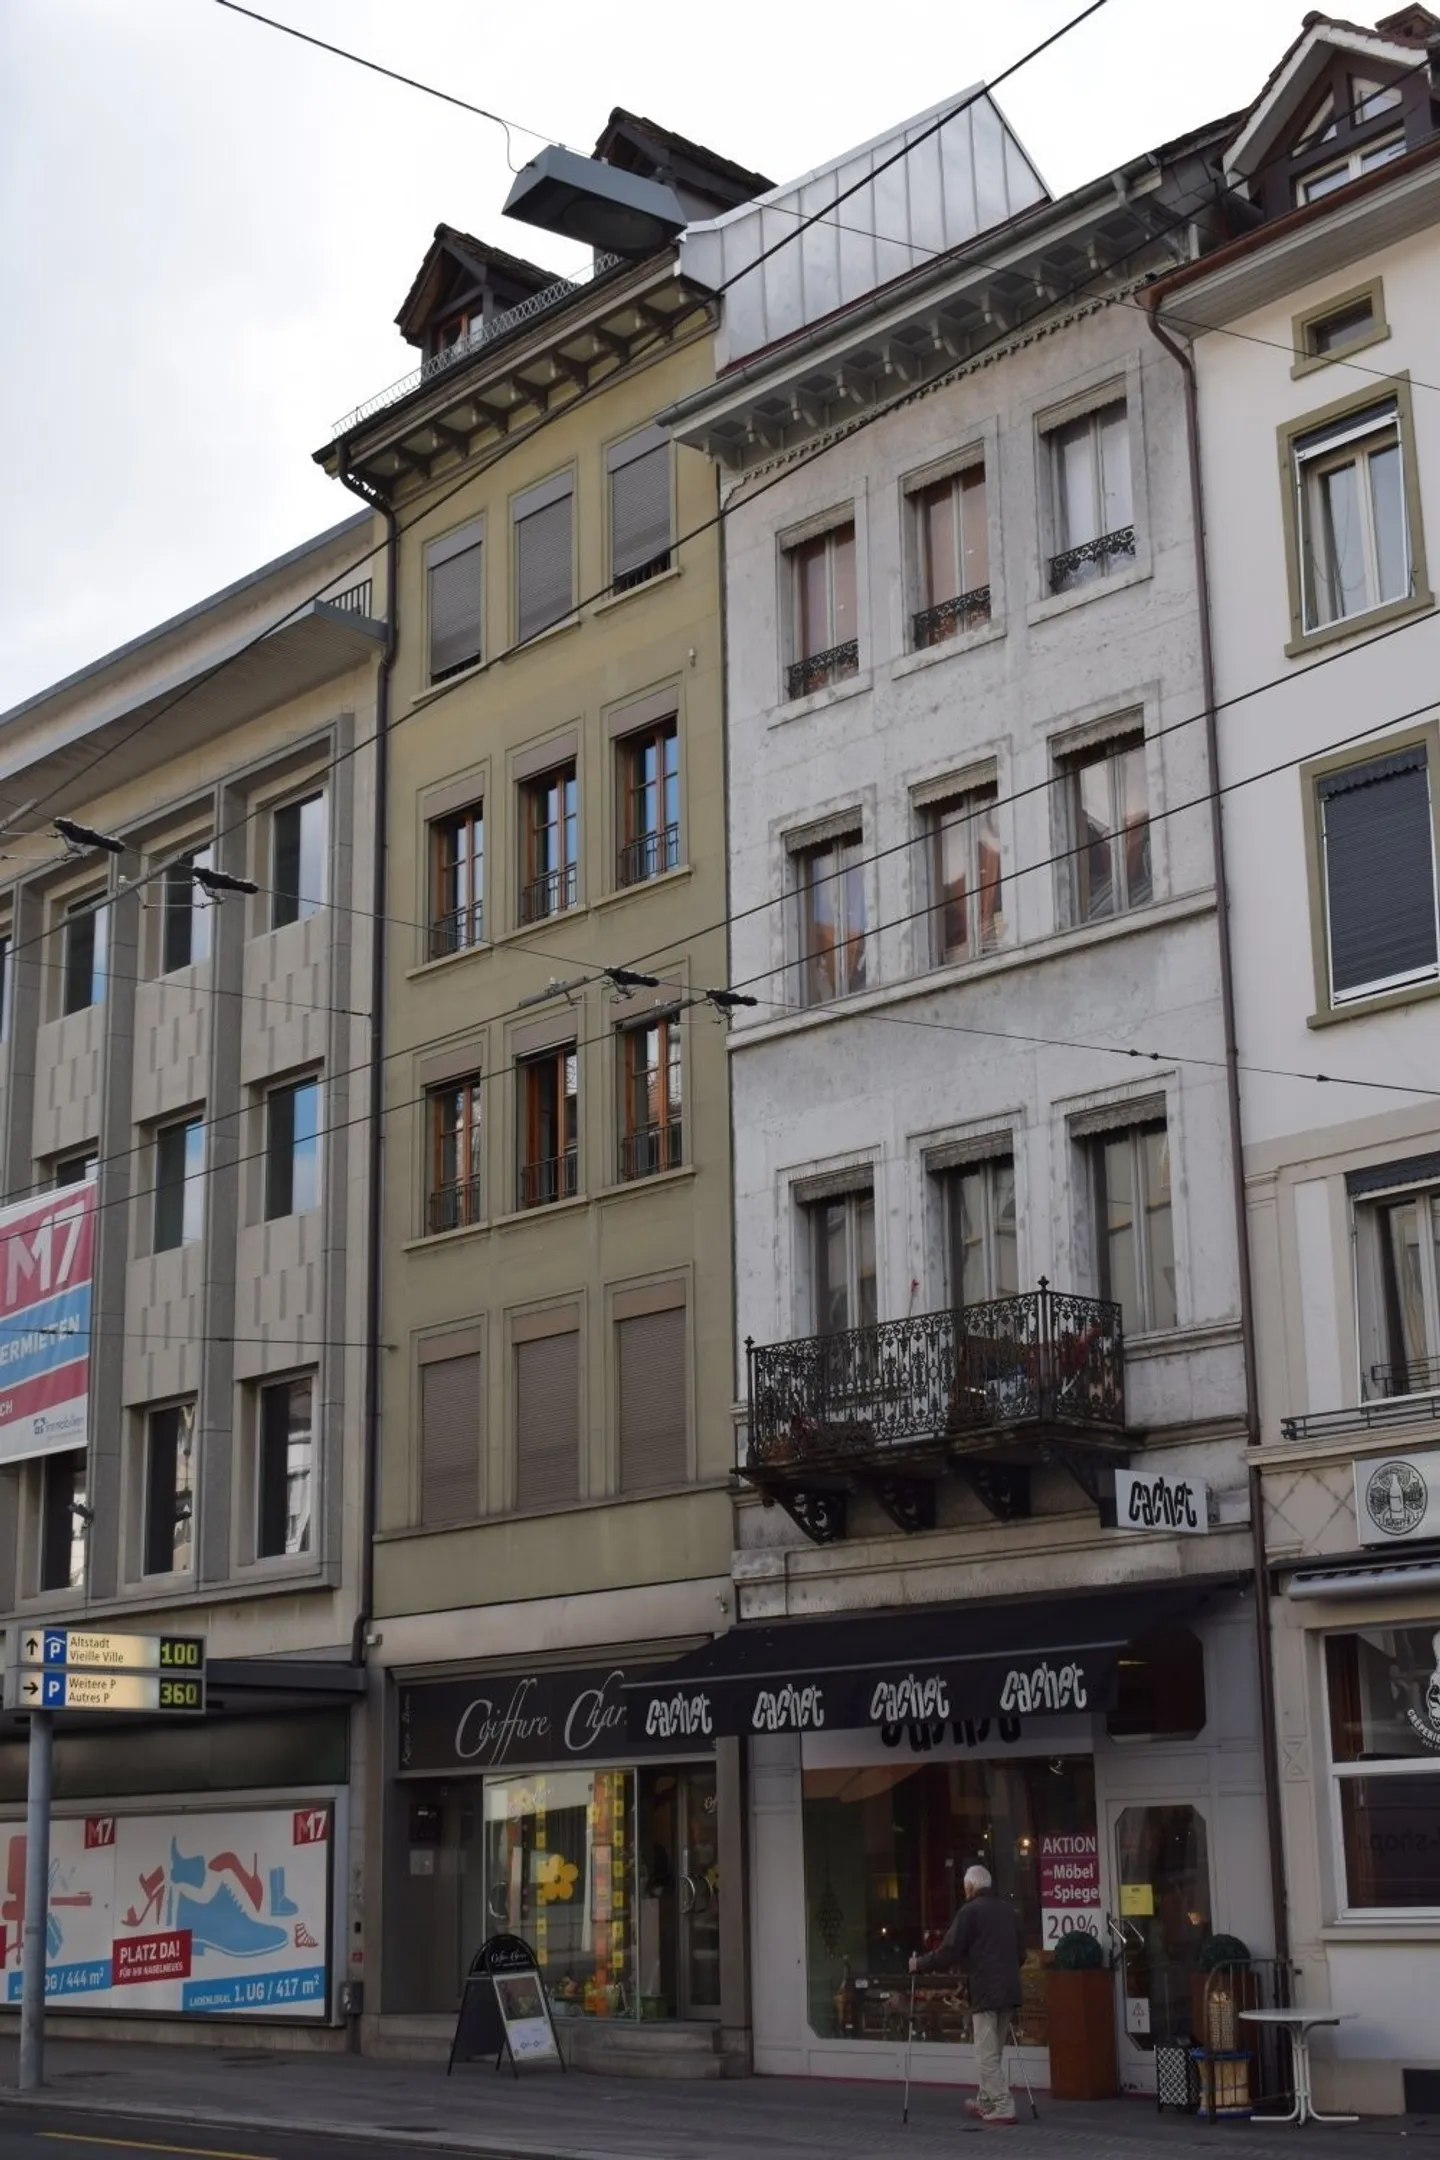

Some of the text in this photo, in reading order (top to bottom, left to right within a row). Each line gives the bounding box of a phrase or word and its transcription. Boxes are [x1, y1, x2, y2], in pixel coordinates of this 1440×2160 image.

[1128, 1476, 1197, 1527] cachet
[70, 1636, 110, 1649] Altstadt
[161, 1644, 198, 1665] 100
[70, 1650, 124, 1664] Vieille Ville
[68, 1676, 108, 1690] Weitere
[110, 1680, 117, 1689] P
[161, 1683, 198, 1705] 360
[68, 1691, 111, 1704] Autres P
[869, 1673, 950, 1721] cachet
[1000, 1661, 1087, 1713] cachet
[645, 1692, 713, 1737] cachet
[752, 1683, 825, 1730] cachet
[455, 1678, 550, 1765] Coiffure
[1042, 1836, 1096, 1854] AKTION
[1054, 1862, 1094, 1879] Möbel
[1047, 1914, 1099, 1939] 20%
[119, 1939, 180, 1964] PLATZ DA!
[66, 1970, 87, 1987] 444
[275, 1977, 299, 1996] 417
